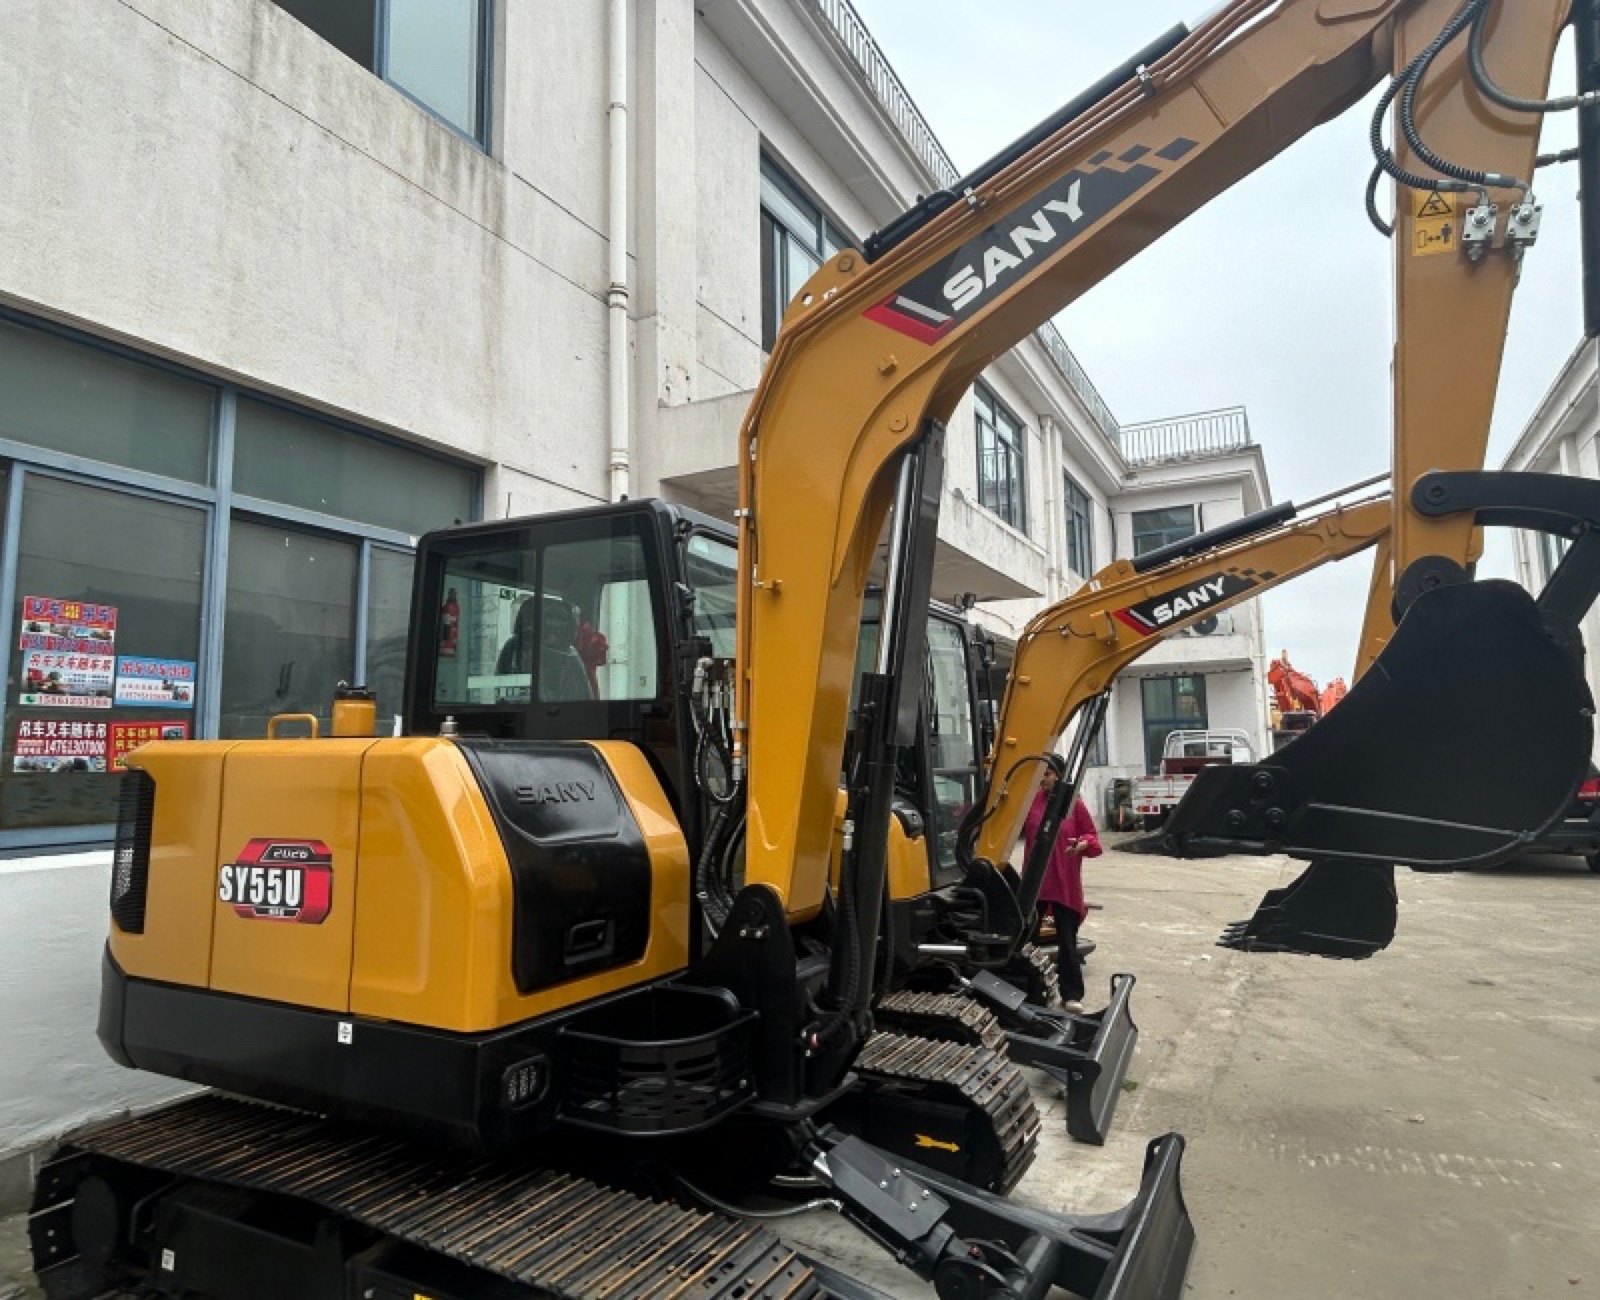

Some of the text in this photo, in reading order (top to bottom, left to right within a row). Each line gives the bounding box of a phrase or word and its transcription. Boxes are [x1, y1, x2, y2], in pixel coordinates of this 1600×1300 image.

[943, 178, 1085, 311] SANY
[1153, 576, 1225, 624] SANY
[514, 781, 595, 805] SANY
[219, 865, 301, 907] SY55U
